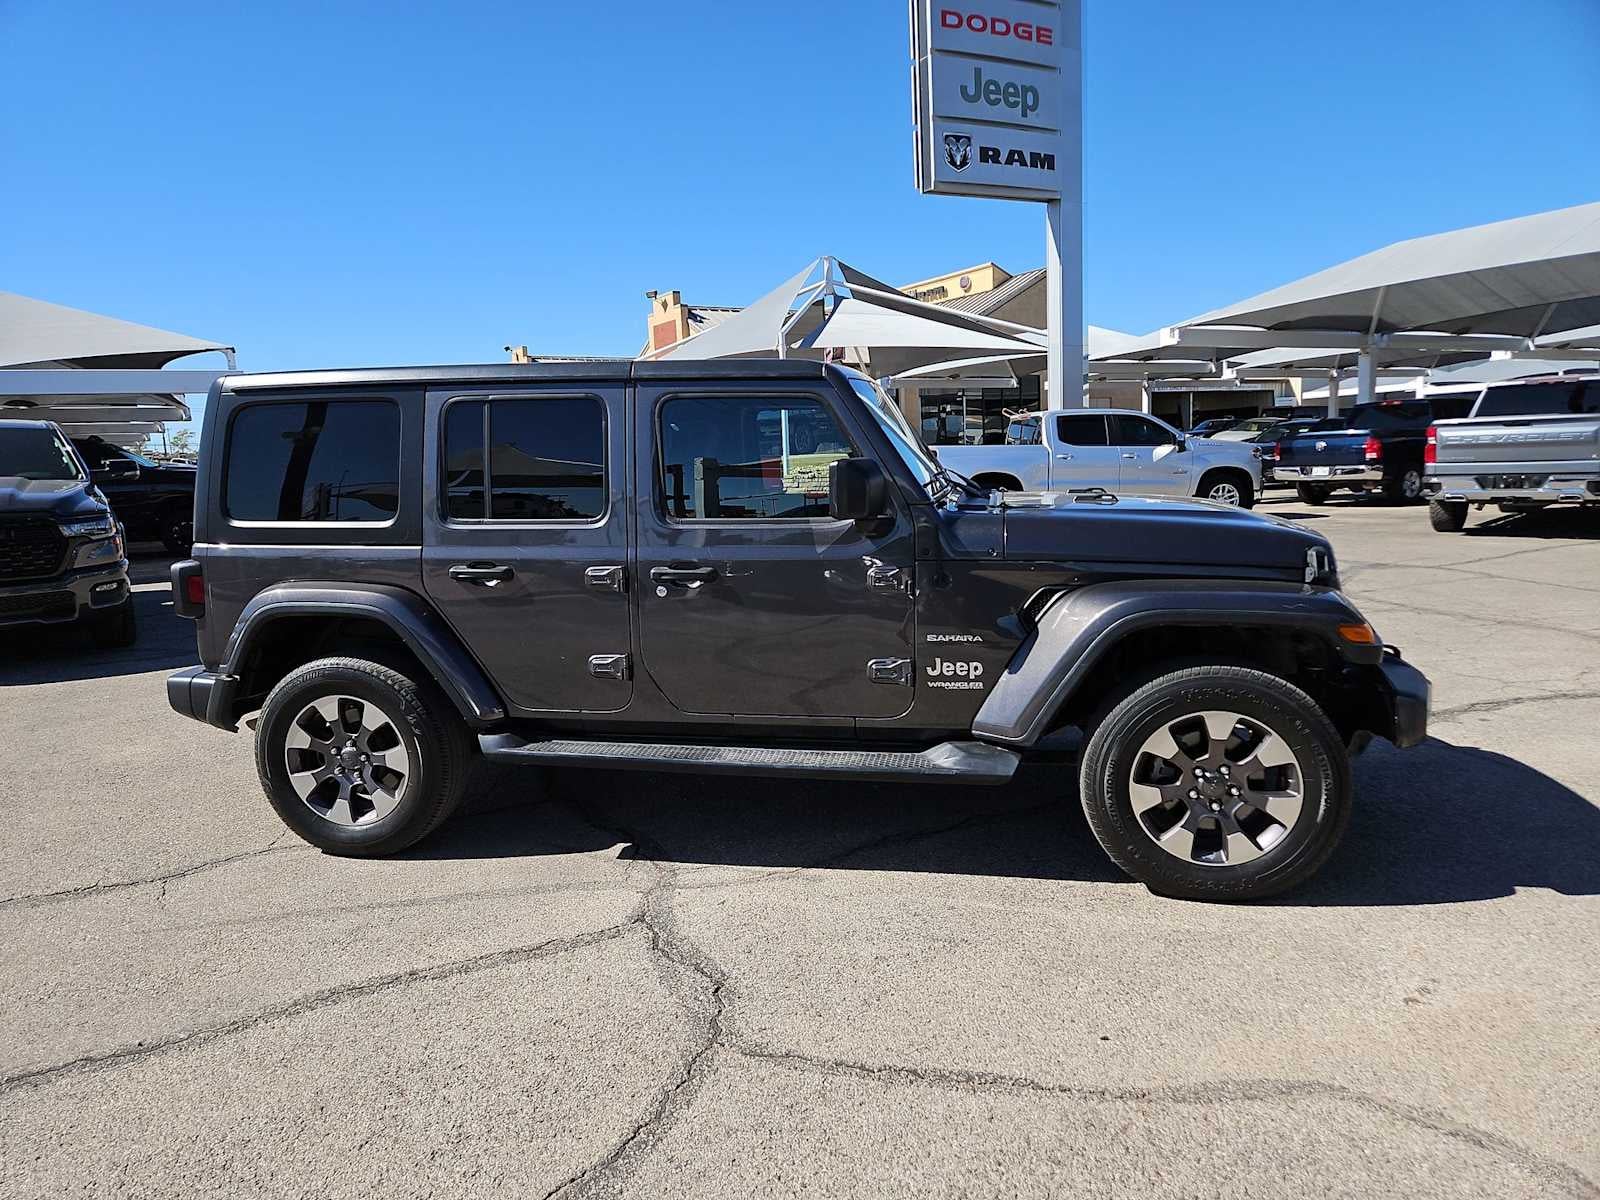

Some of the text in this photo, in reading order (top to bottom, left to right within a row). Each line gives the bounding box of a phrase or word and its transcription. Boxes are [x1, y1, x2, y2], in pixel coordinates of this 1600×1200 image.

[941, 9, 1053, 46] DODGE
[959, 67, 1040, 117] Jeep
[979, 146, 1056, 171] RAM
[1446, 432, 1593, 444] CHEVROLET
[926, 634, 983, 642] SAHARA
[926, 657, 984, 679] Jeep
